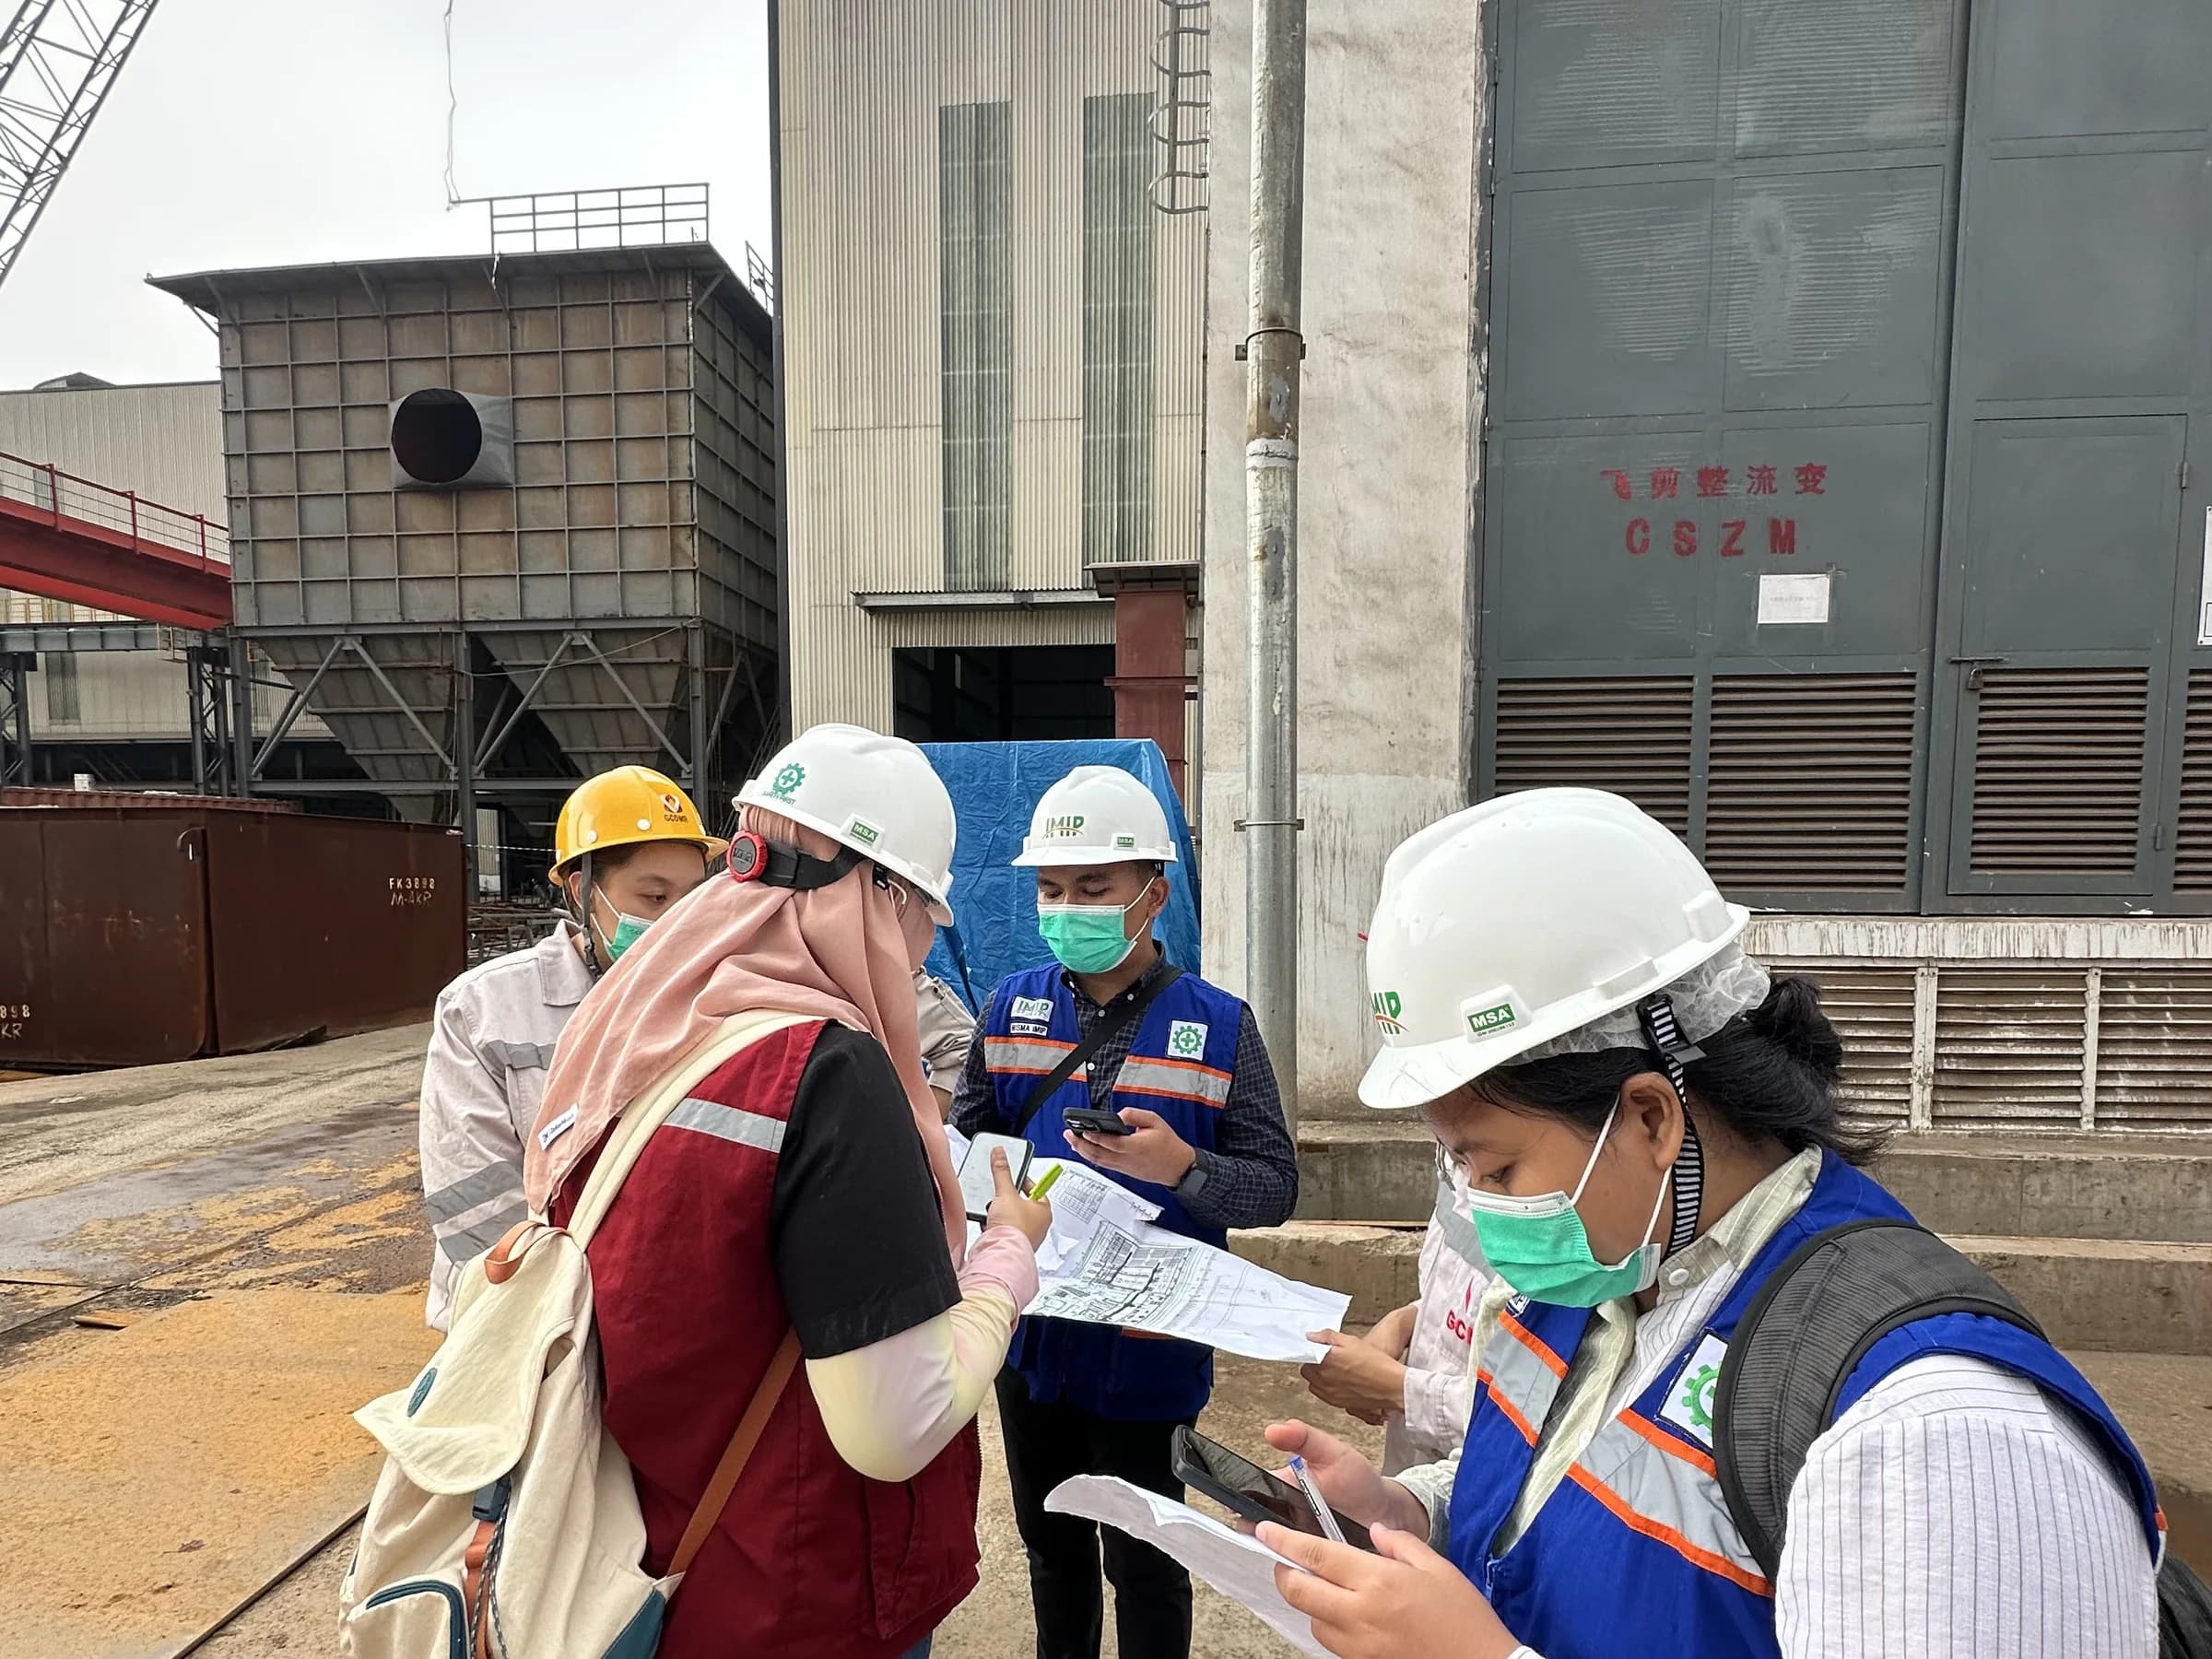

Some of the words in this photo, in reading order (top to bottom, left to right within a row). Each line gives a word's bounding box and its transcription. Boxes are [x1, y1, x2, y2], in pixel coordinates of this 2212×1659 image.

[853, 823, 876, 841] MSA
[1045, 816, 1085, 838] IMIP
[0, 1004, 30, 1018] 898
[1370, 991, 1402, 1035] MIP
[1472, 1008, 1511, 1029] MSA
